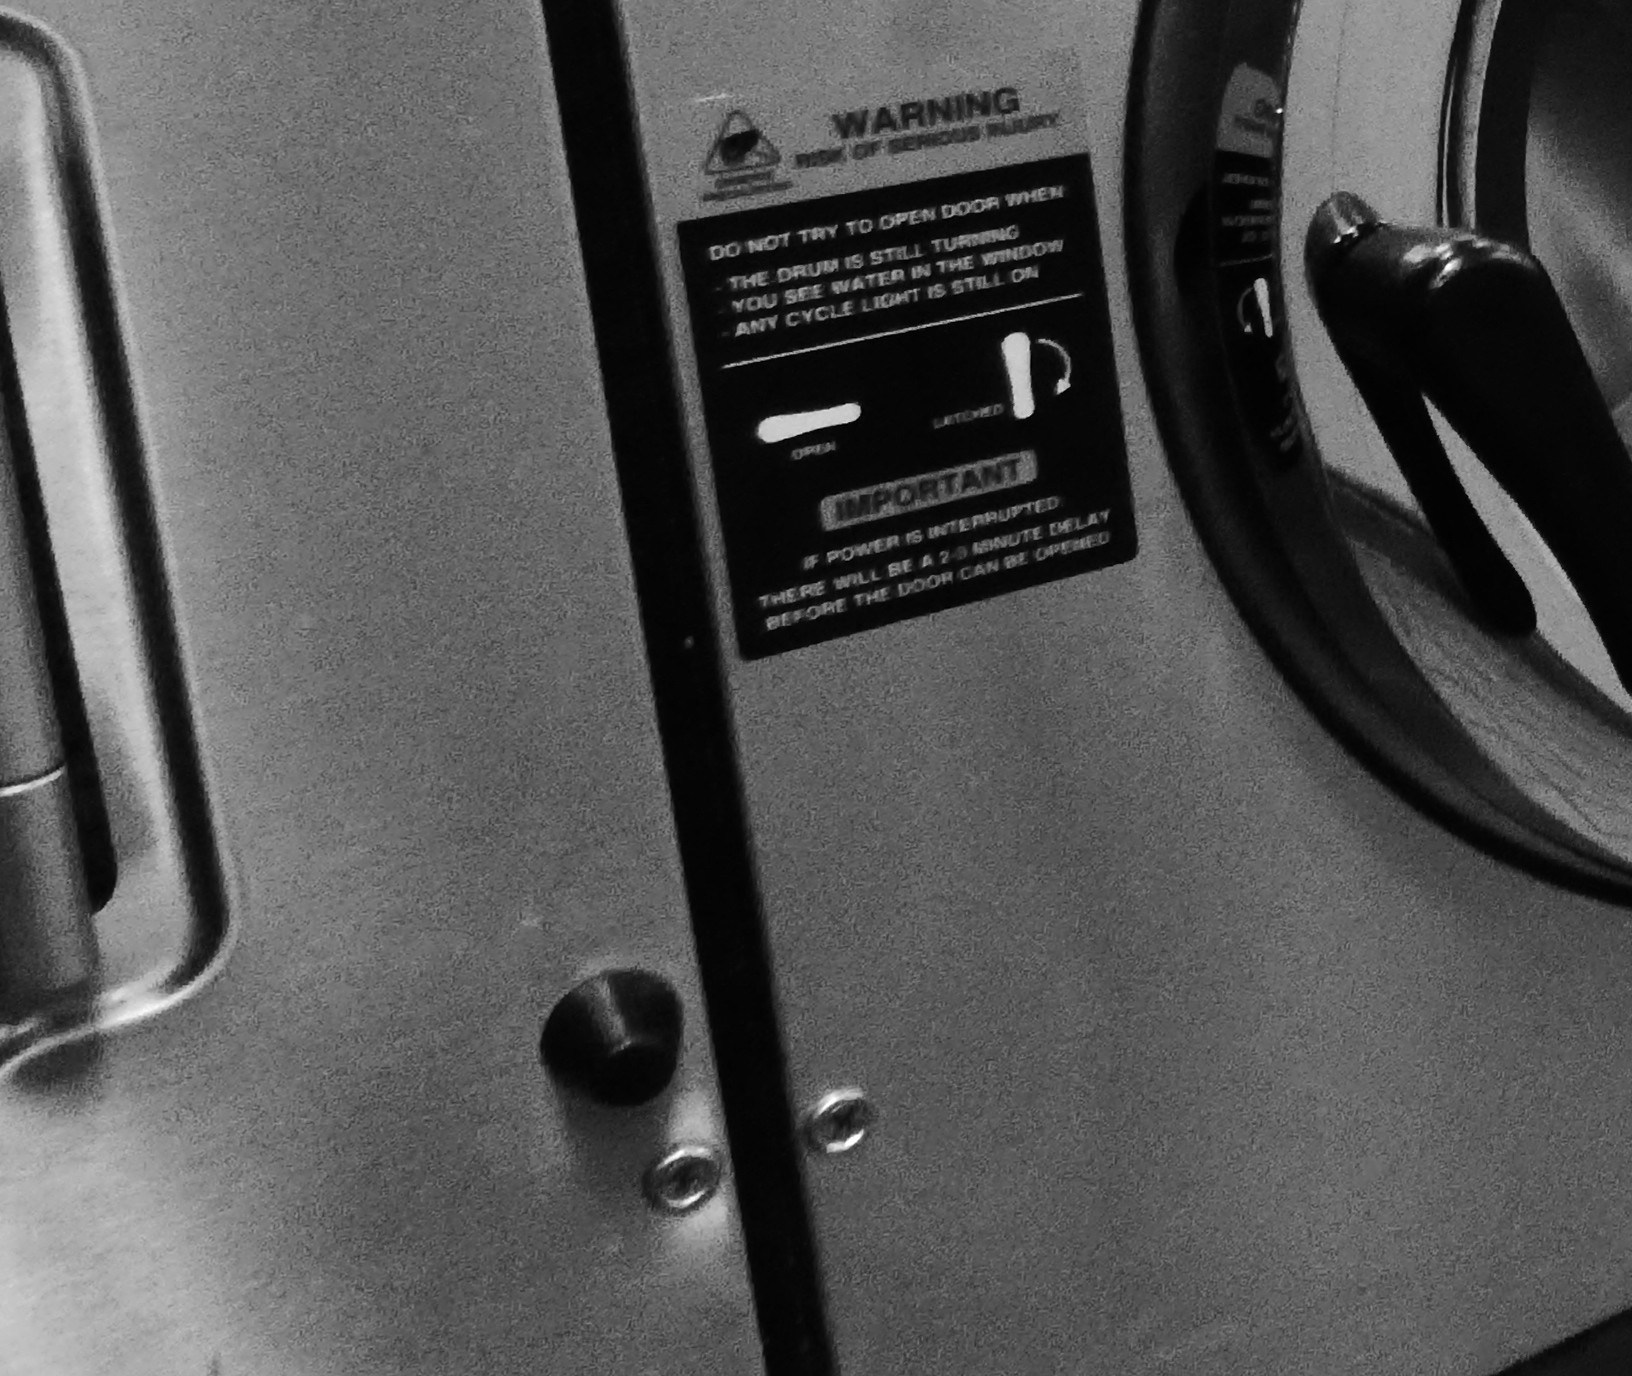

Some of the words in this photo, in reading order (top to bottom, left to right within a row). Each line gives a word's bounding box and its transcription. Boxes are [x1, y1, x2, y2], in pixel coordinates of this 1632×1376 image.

[831, 86, 1021, 140] WARNING
[709, 241, 742, 261] DO
[746, 232, 792, 254] NOT
[797, 224, 839, 244] TRY
[845, 217, 874, 236] TO
[880, 207, 937, 230] OPEN
[941, 196, 1000, 220] DOOR
[1004, 185, 1064, 208] WHEN
[728, 271, 770, 291] THE
[776, 258, 839, 284] DRUM
[844, 253, 865, 270] IS
[869, 243, 925, 266] STILL
[931, 224, 1020, 254] TURNING
[731, 293, 779, 314] YOU
[784, 283, 825, 305] SEE
[831, 268, 905, 296] WATER
[911, 263, 932, 280] IN
[936, 254, 976, 274] THE
[981, 239, 1064, 267] WINDOW
[735, 314, 779, 338] ANY
[785, 300, 854, 327] CYCLE
[861, 288, 921, 313] LIGHT
[927, 283, 946, 299] IS
[951, 273, 1005, 295] STILL
[1011, 265, 1039, 283] ON
[834, 457, 1021, 523] IMPORTANT
[758, 579, 827, 609] THERE
[832, 569, 883, 591] WILL
[887, 558, 914, 578] BE
[920, 553, 934, 570] A
[971, 526, 1045, 556] MINUTE
[1049, 508, 1112, 538] DELAY
[802, 553, 820, 571] IF
[826, 534, 901, 564] POWER
[905, 528, 924, 546] IS
[926, 496, 1060, 539] INTERRUPTED
[766, 597, 849, 632] BEFORE
[853, 586, 893, 607] THE
[897, 570, 954, 599] DOOR
[959, 558, 1000, 581] CAN
[1003, 550, 1030, 571] BE
